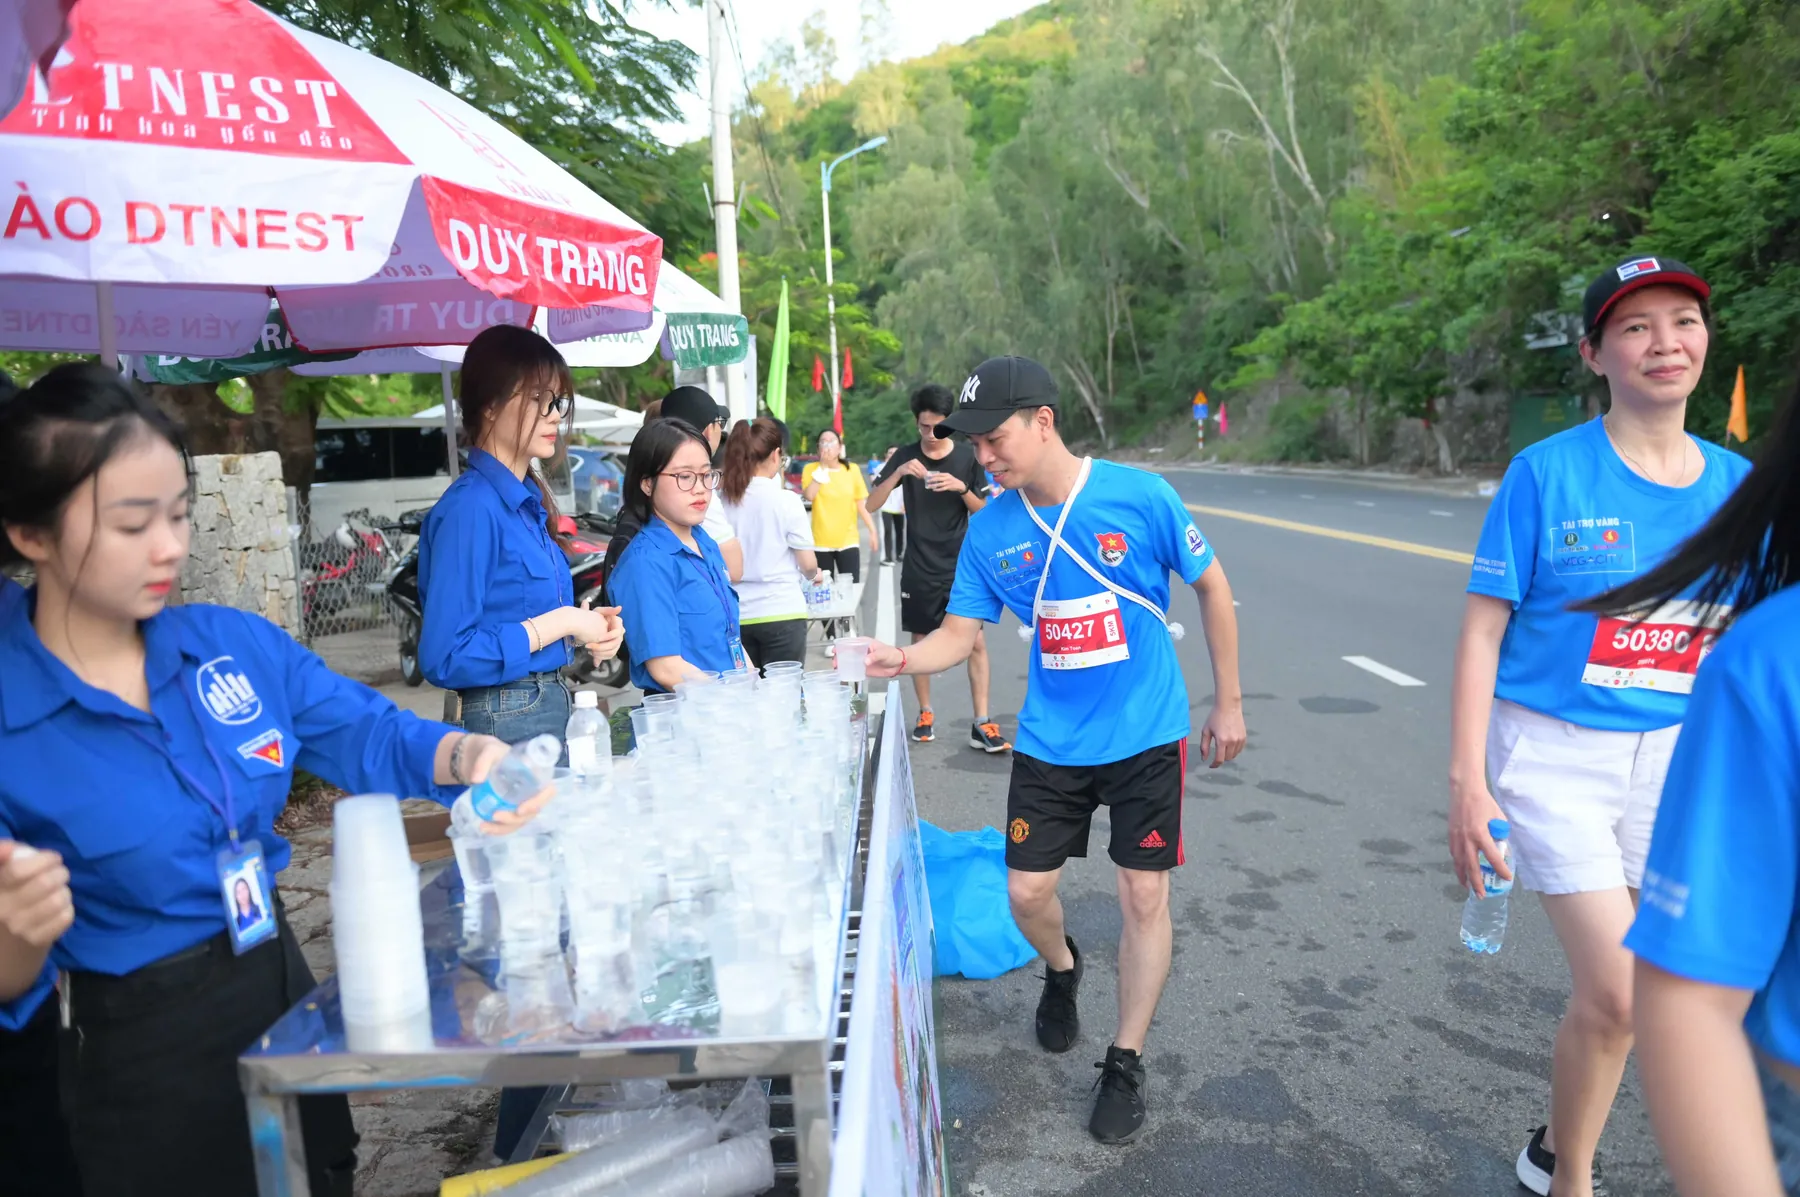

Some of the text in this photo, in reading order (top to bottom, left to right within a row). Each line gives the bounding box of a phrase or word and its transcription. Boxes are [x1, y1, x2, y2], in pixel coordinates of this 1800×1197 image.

[125, 201, 364, 252] DTNEST
[449, 218, 529, 276] DUY
[536, 236, 648, 295] TRANG
[670, 322, 740, 350] DUY TRANG
[1045, 619, 1095, 640] 50427
[1107, 620, 1117, 637] 5KM
[1611, 627, 1691, 654] 50380
[1139, 840, 1168, 848] adidas
